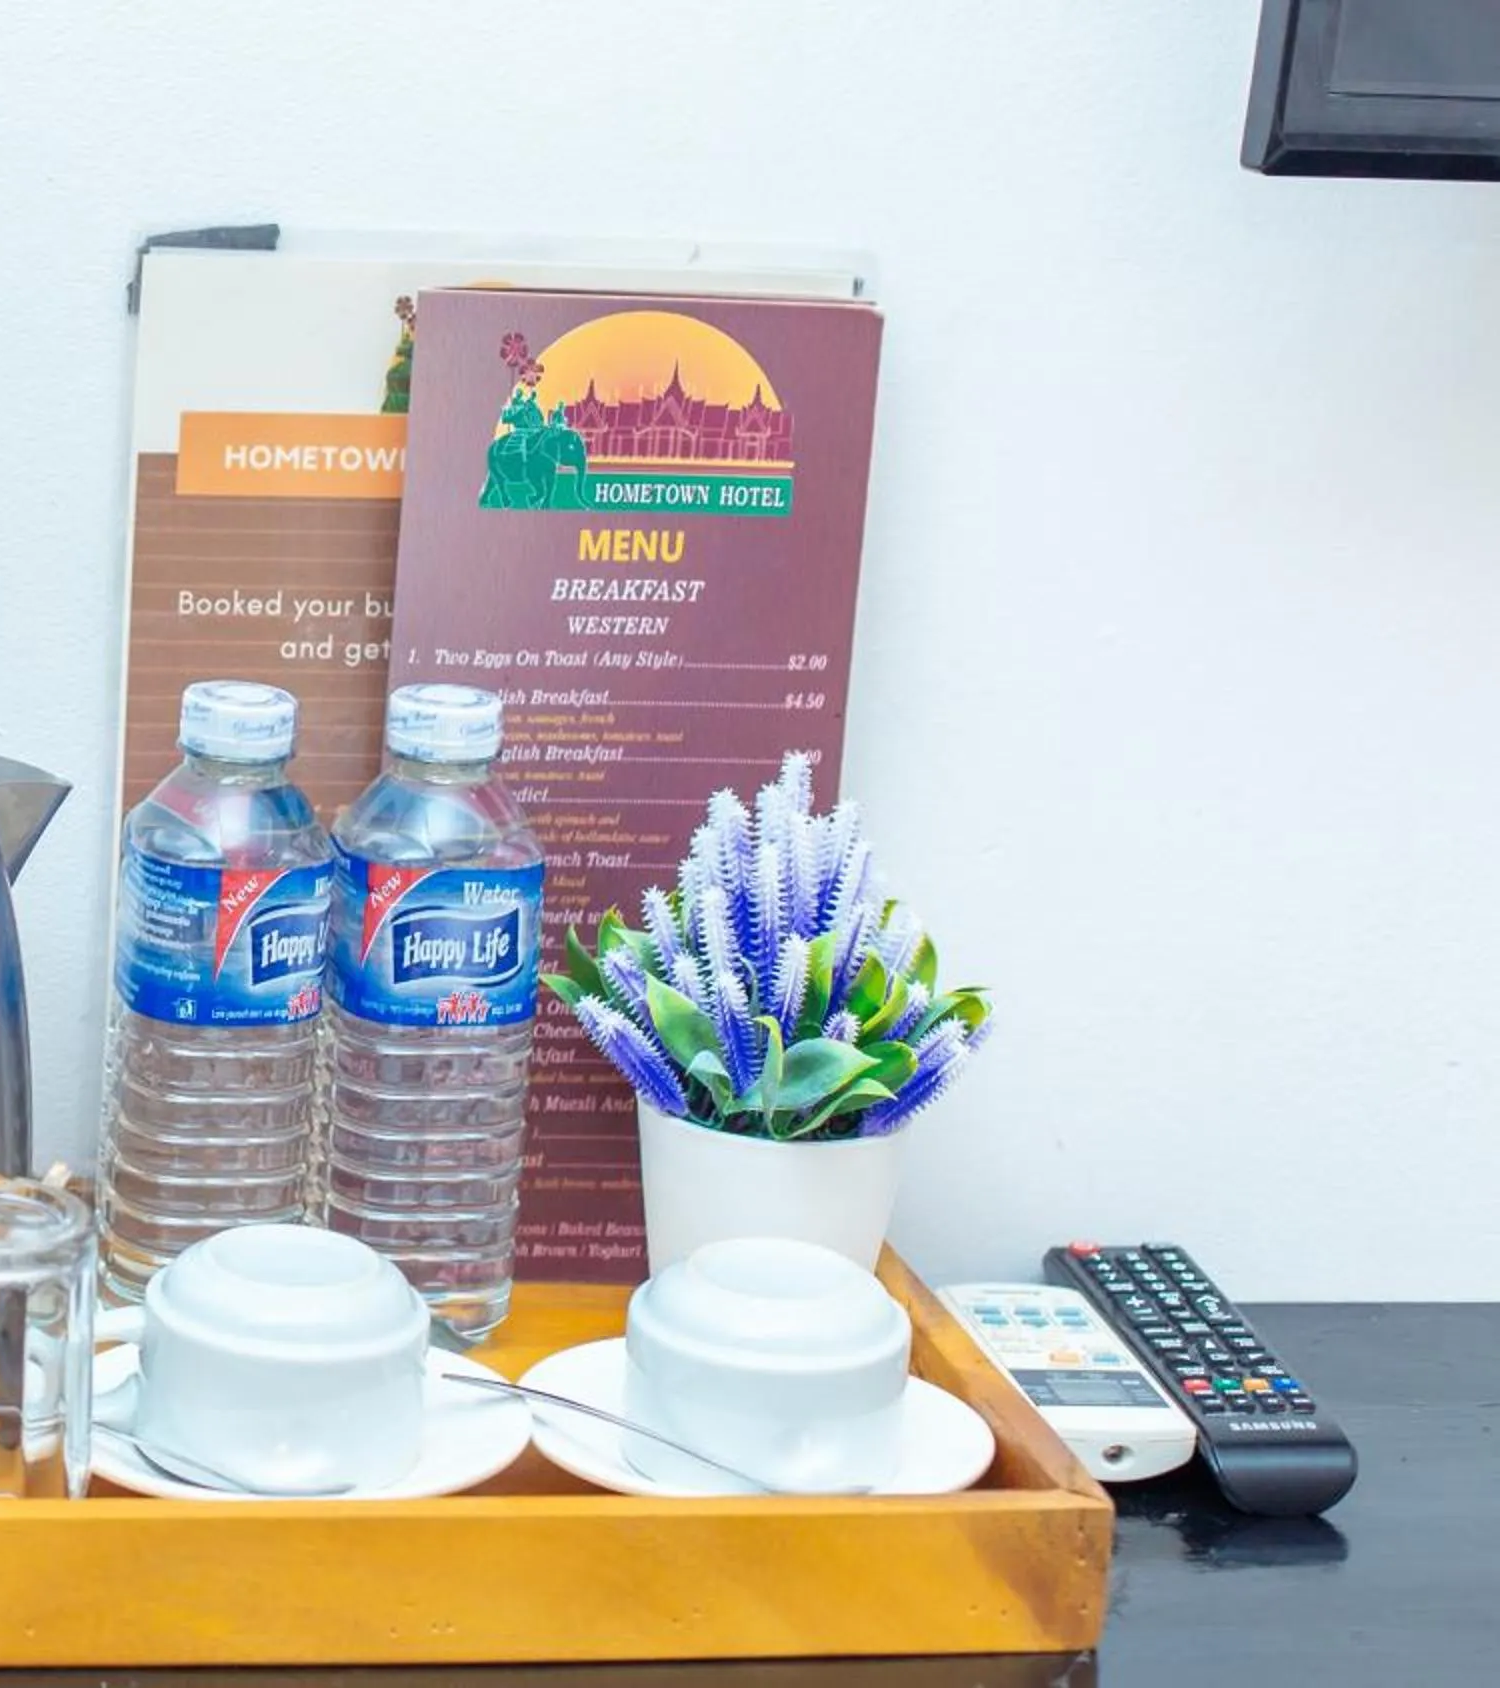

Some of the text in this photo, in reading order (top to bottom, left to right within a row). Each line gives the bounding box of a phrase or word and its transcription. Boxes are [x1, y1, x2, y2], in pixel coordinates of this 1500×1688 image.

[224, 445, 406, 472] HOMETOW
[595, 483, 785, 507] HOMETOWN HOTEL
[578, 529, 685, 563] MENU
[551, 579, 705, 602] BREAKFAST
[178, 589, 283, 616] Booked
[293, 597, 353, 623] your
[567, 616, 670, 635] WESTERN
[280, 635, 390, 666] and get
[435, 649, 470, 665] Two
[473, 650, 511, 668] Eggs
[516, 651, 539, 666] On
[545, 650, 587, 667] Toast
[593, 651, 631, 669] (Any
[787, 655, 828, 671] $2.00
[497, 689, 826, 709] lish Breakfast $4.50
[501, 745, 540, 763] glish
[545, 745, 624, 765] Breakfast
[513, 786, 549, 803] dict
[587, 851, 630, 868] Toast
[220, 876, 260, 914] New
[369, 872, 403, 909] New
[463, 881, 520, 906] Water
[260, 929, 316, 968] Happy
[403, 927, 511, 970] Happy Life
[1228, 1421, 1317, 1432] SAMSUNG
